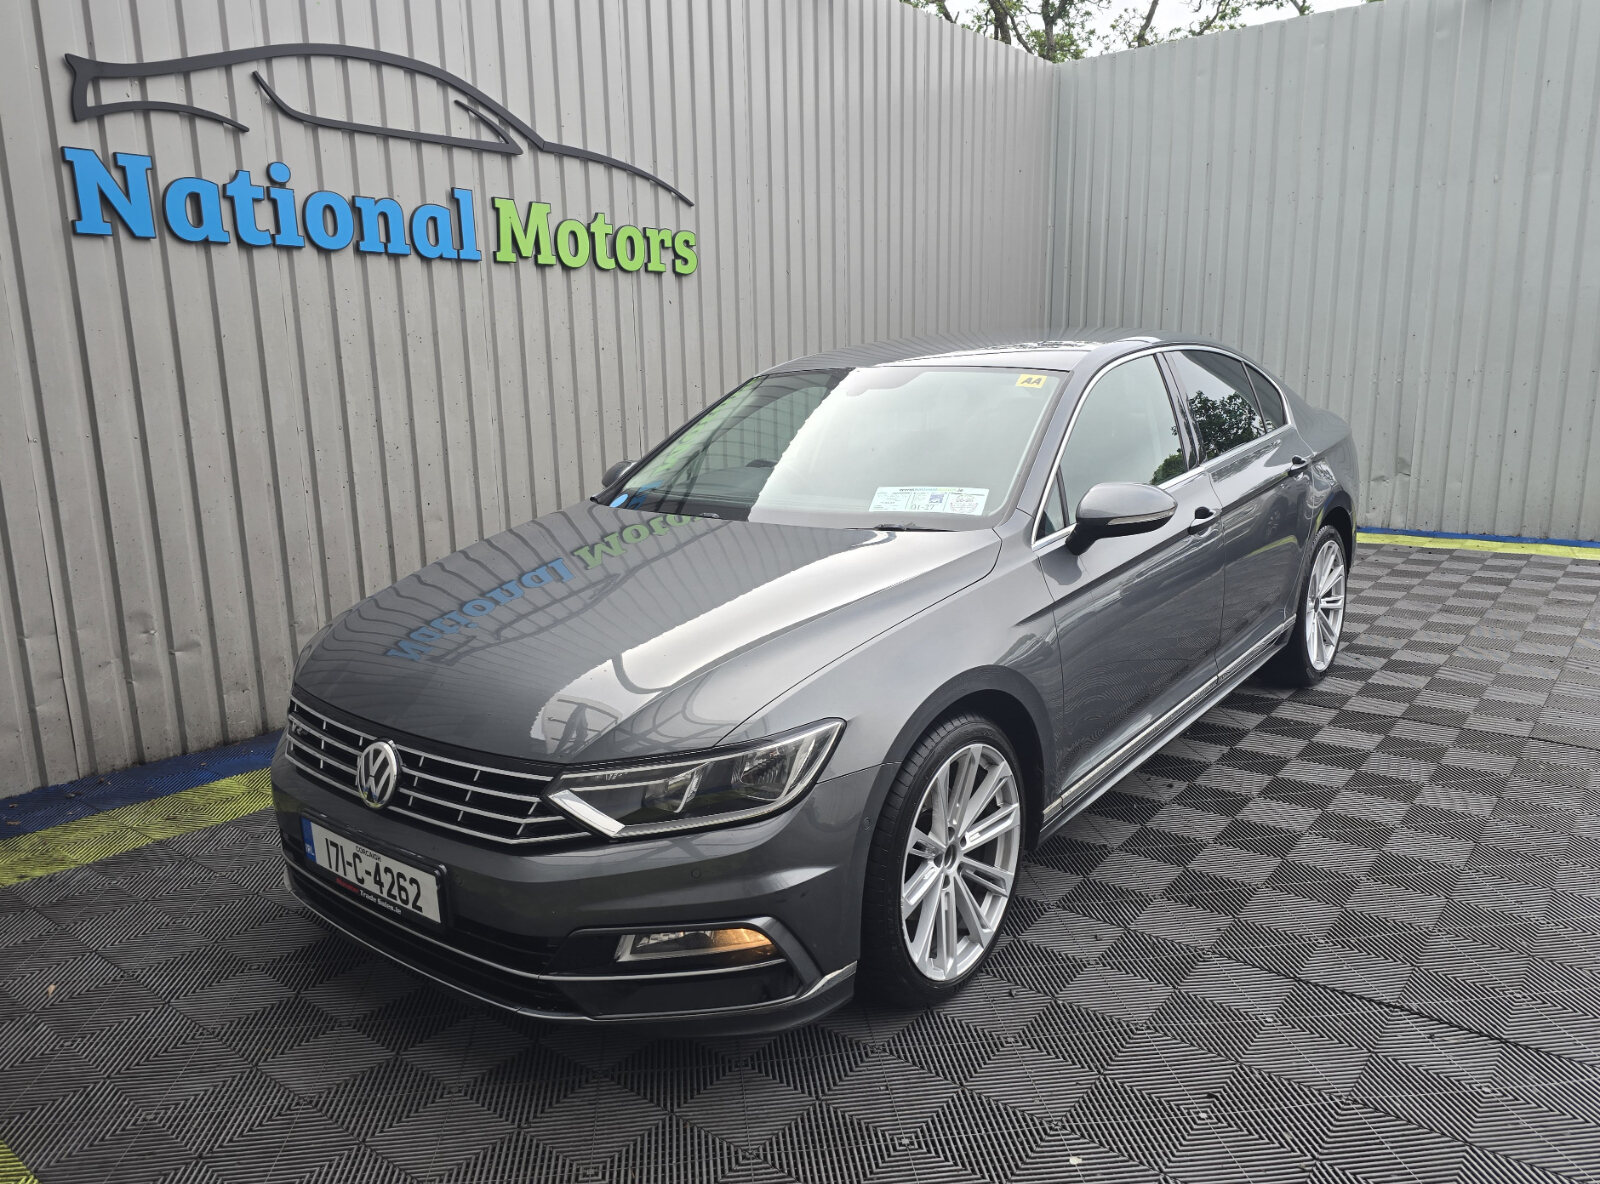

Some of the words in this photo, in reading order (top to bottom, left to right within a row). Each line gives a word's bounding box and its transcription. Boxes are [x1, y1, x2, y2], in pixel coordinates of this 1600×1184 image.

[62, 146, 482, 261] National
[493, 197, 699, 275] Motors
[1021, 377, 1042, 385] AA
[325, 838, 423, 913] 171-C-4262
